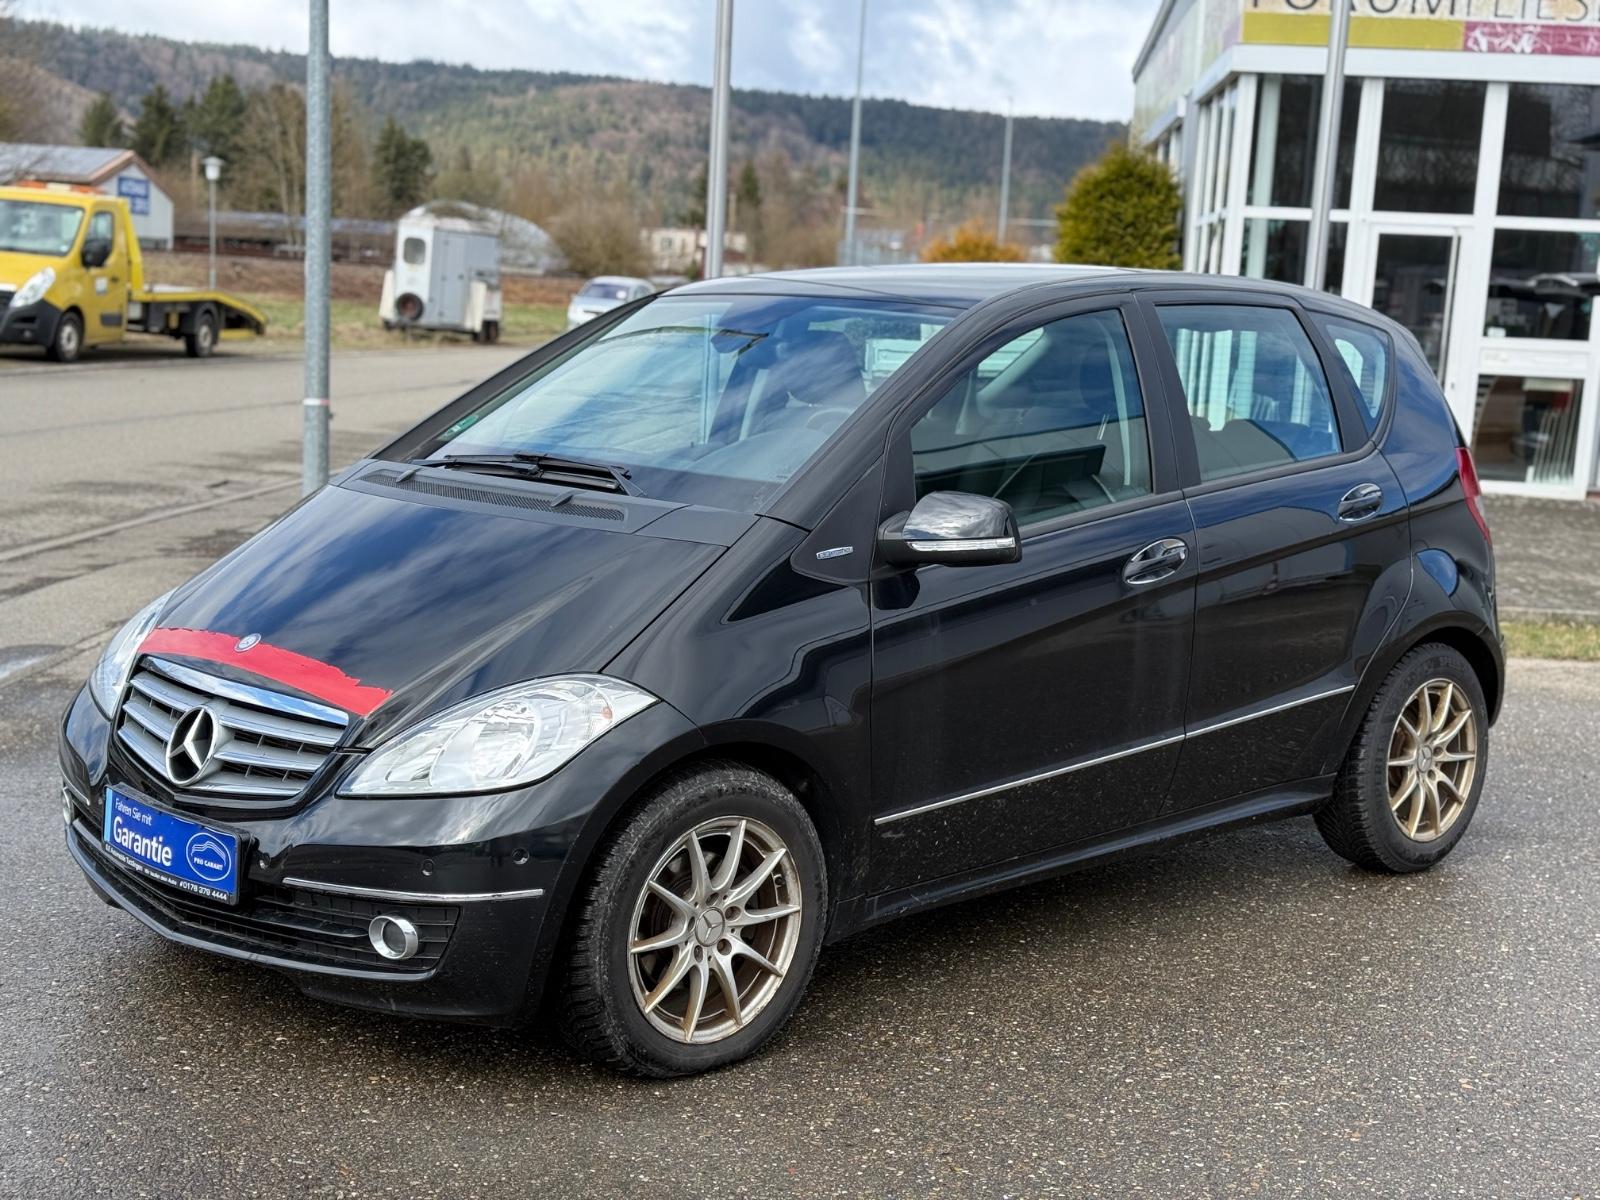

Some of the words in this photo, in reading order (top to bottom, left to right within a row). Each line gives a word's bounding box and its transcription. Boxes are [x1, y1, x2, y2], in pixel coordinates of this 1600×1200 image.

[115, 798, 132, 816] Fahren
[132, 807, 141, 822] Sie
[141, 814, 152, 826] mit
[113, 816, 172, 867] Garantie
[193, 857, 204, 865] PRO
